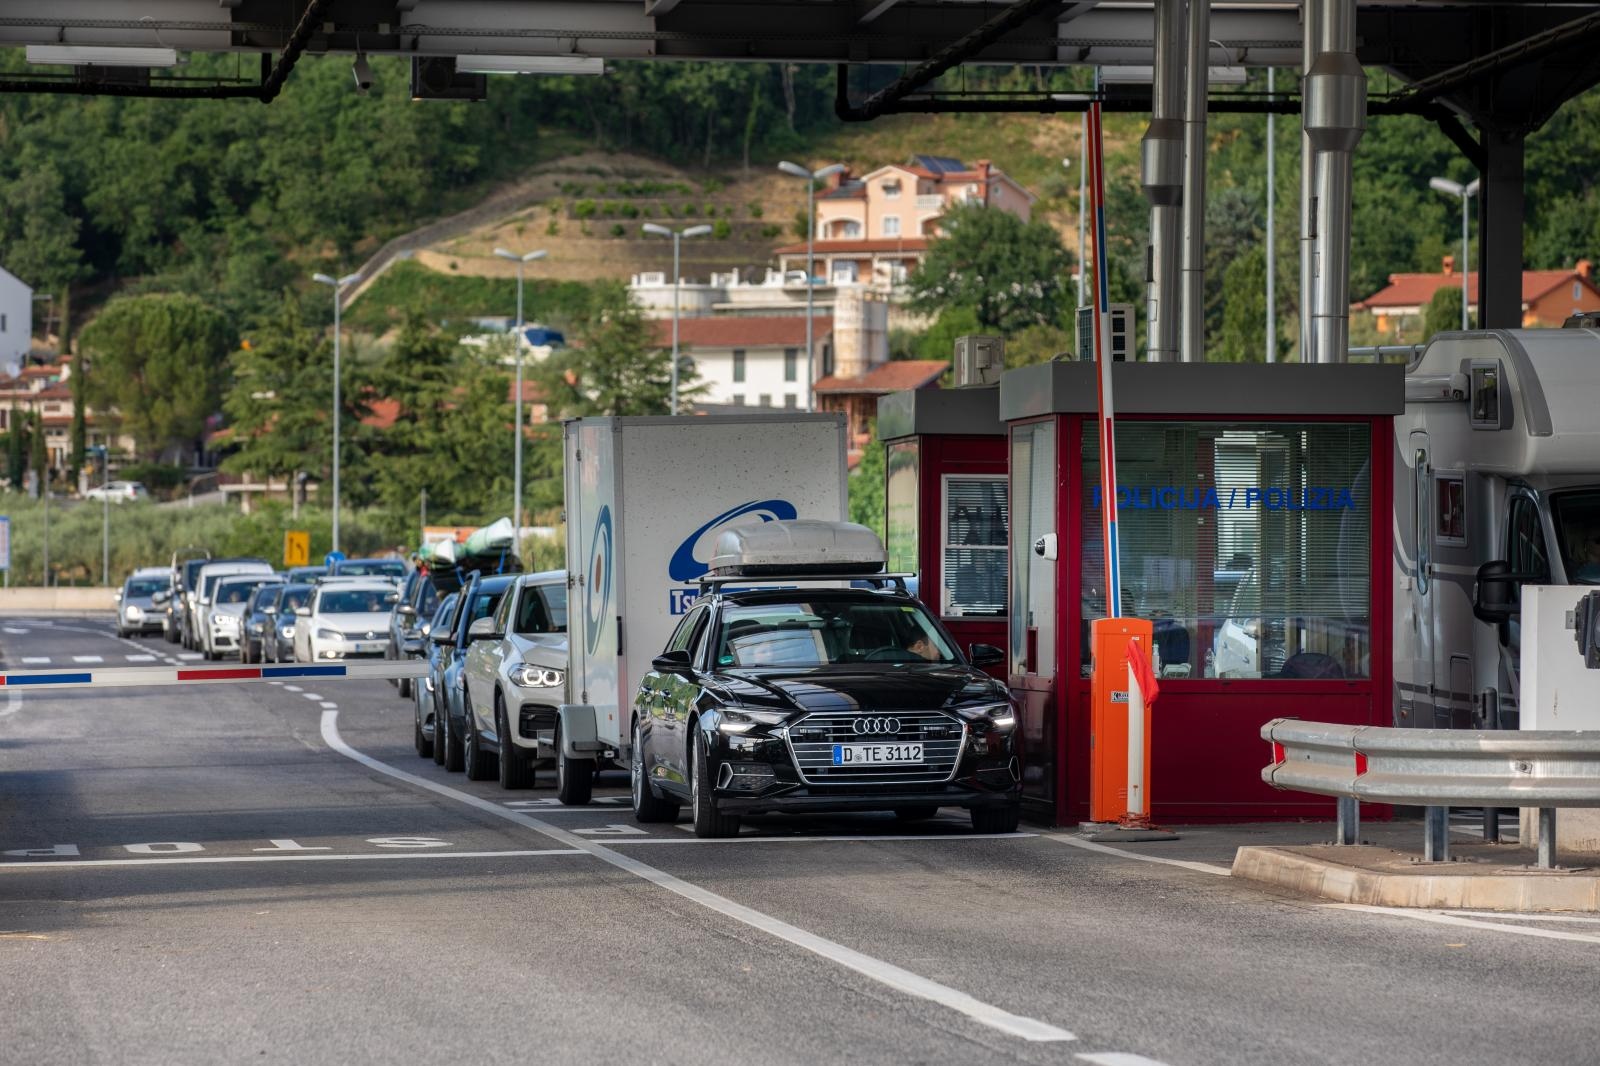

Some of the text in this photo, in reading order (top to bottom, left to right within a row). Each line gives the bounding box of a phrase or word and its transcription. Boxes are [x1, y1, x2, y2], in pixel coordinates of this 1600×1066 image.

[1092, 487, 1221, 510] POLICIJA
[1245, 487, 1356, 510] POLIZIA
[843, 747, 853, 762] D
[863, 747, 882, 761] TE
[885, 746, 921, 761] 3112
